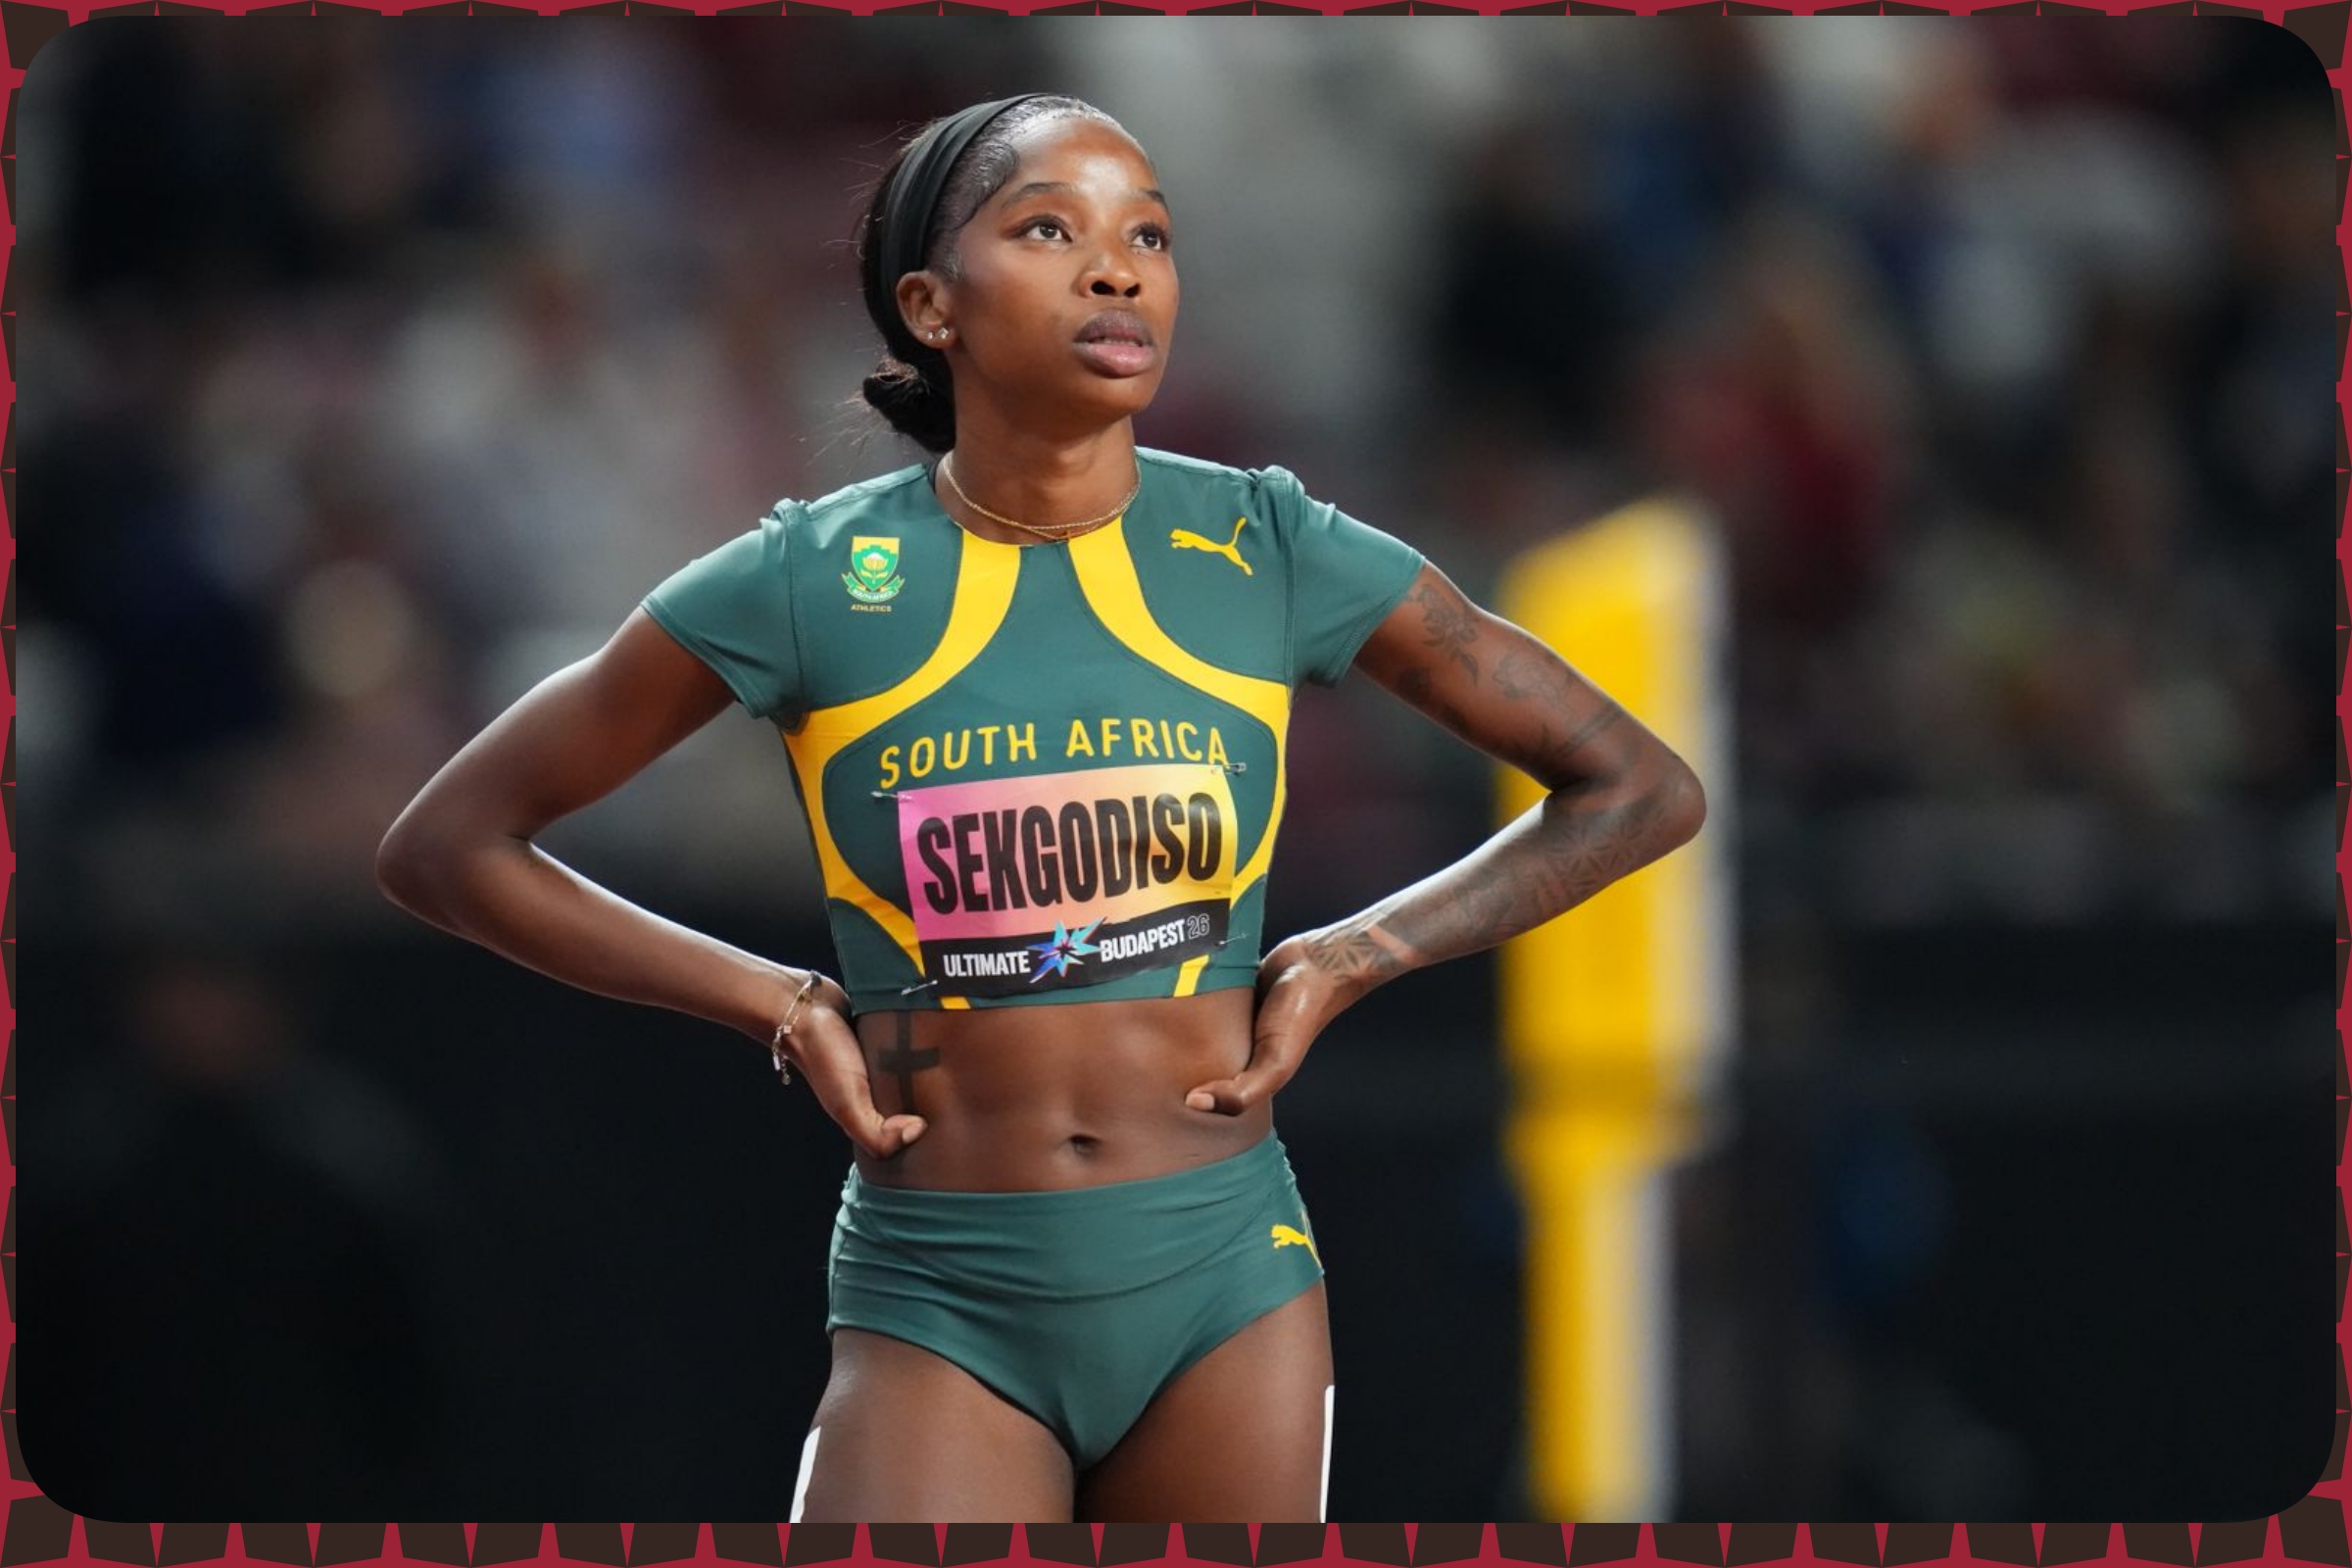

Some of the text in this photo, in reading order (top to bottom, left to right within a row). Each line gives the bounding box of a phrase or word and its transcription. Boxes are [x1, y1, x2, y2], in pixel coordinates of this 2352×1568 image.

[880, 718, 1229, 789] SOUTH AFRICA
[916, 792, 1223, 915] SEKGODISO
[943, 913, 1210, 978] ULTIMATE BUDAPEST 26
